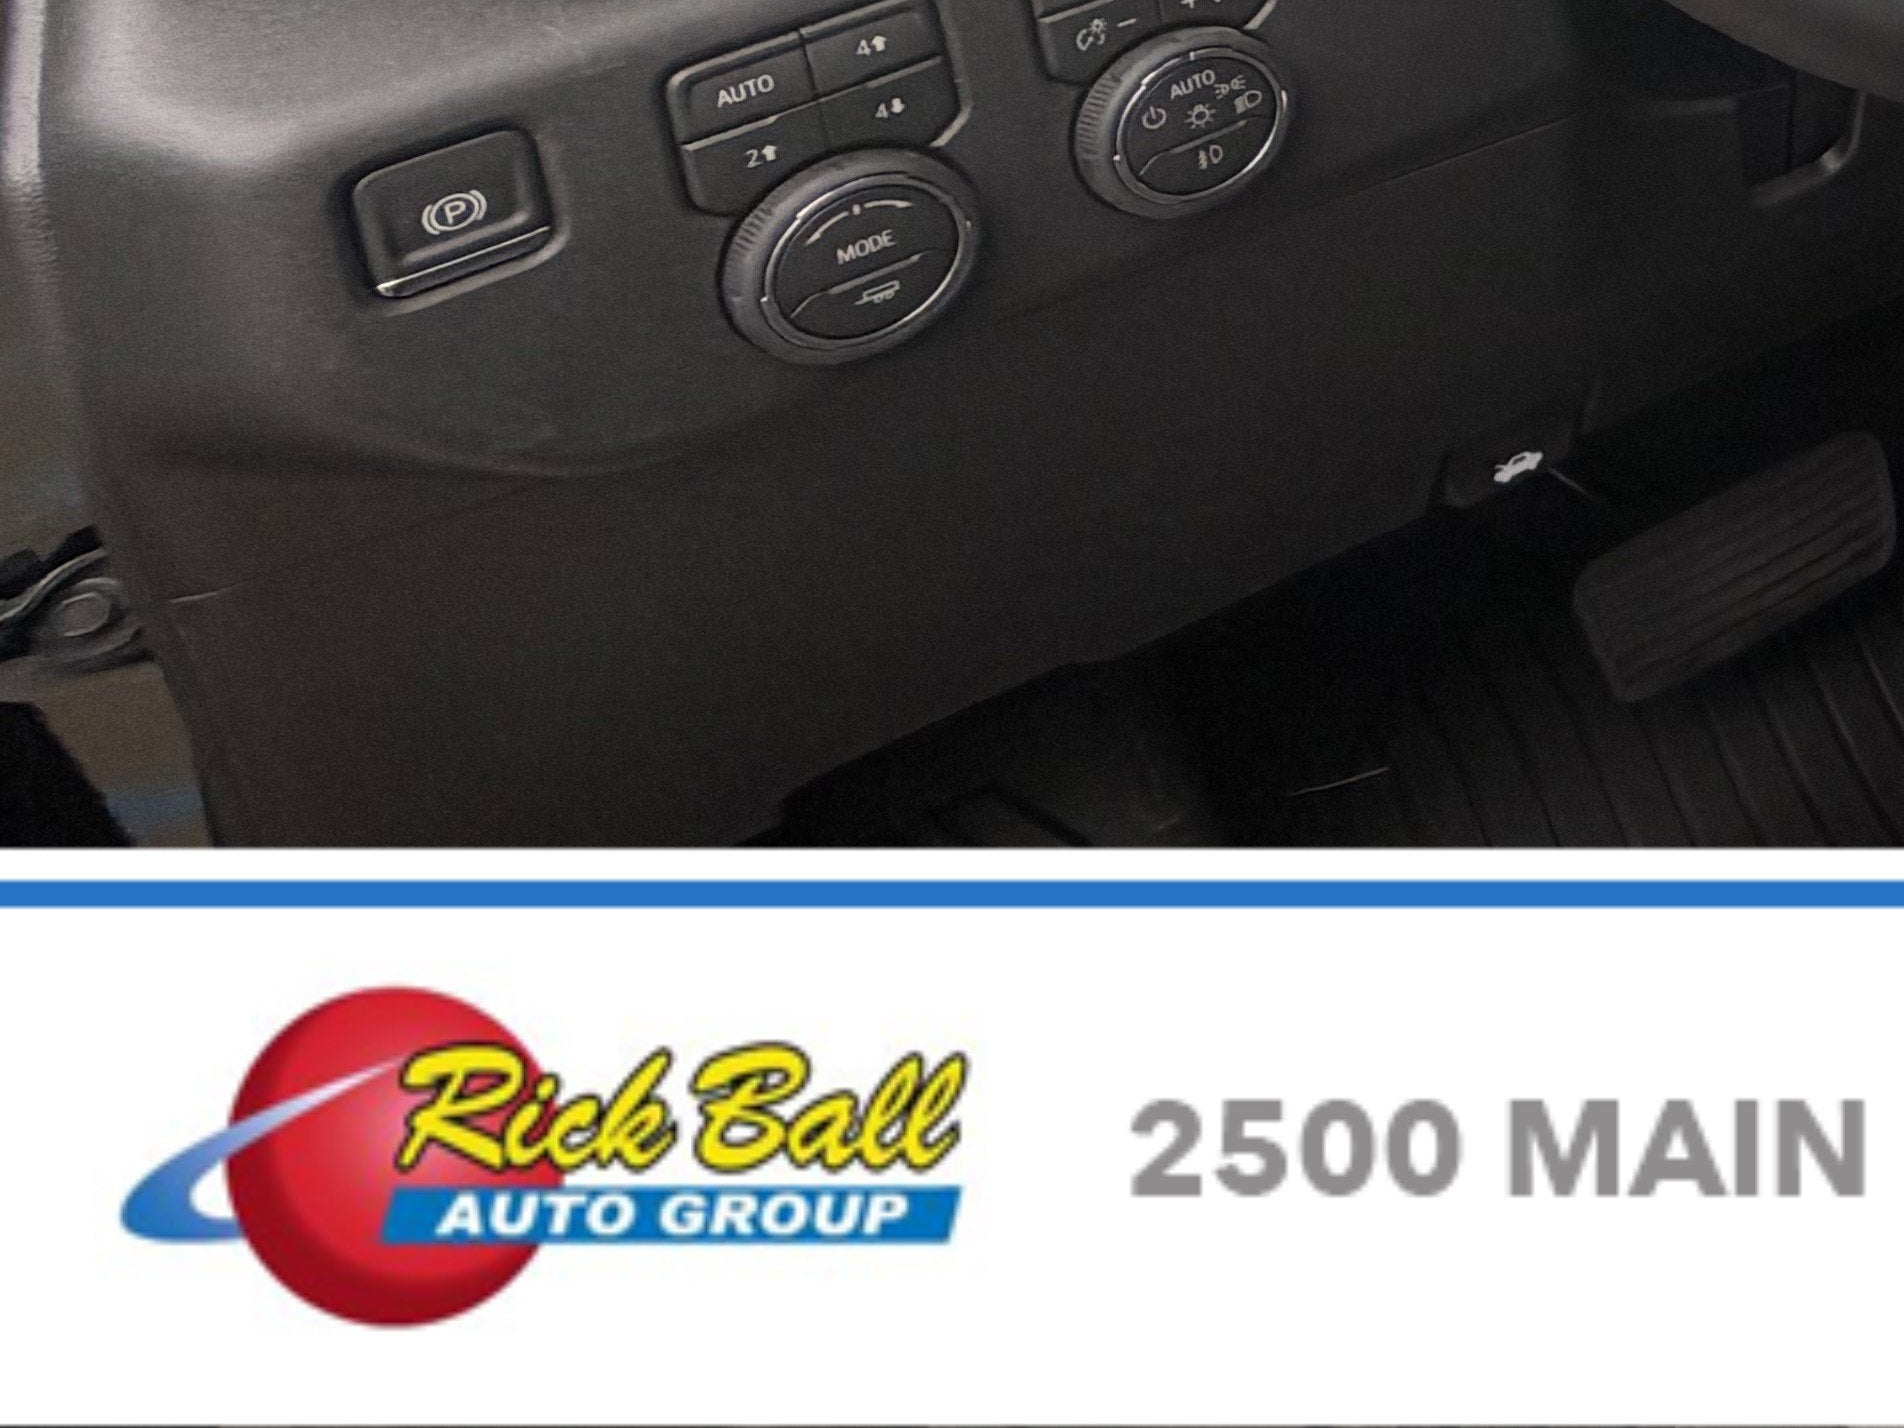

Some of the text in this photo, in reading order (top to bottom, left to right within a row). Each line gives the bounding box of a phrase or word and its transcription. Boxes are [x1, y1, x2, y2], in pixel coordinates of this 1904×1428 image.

[855, 39, 872, 56] 4
[717, 74, 776, 109] AUTO
[1170, 69, 1217, 100] AUTO
[875, 102, 889, 120] 4
[745, 149, 762, 169] 2
[443, 200, 467, 225] P
[836, 229, 895, 265] MODE
